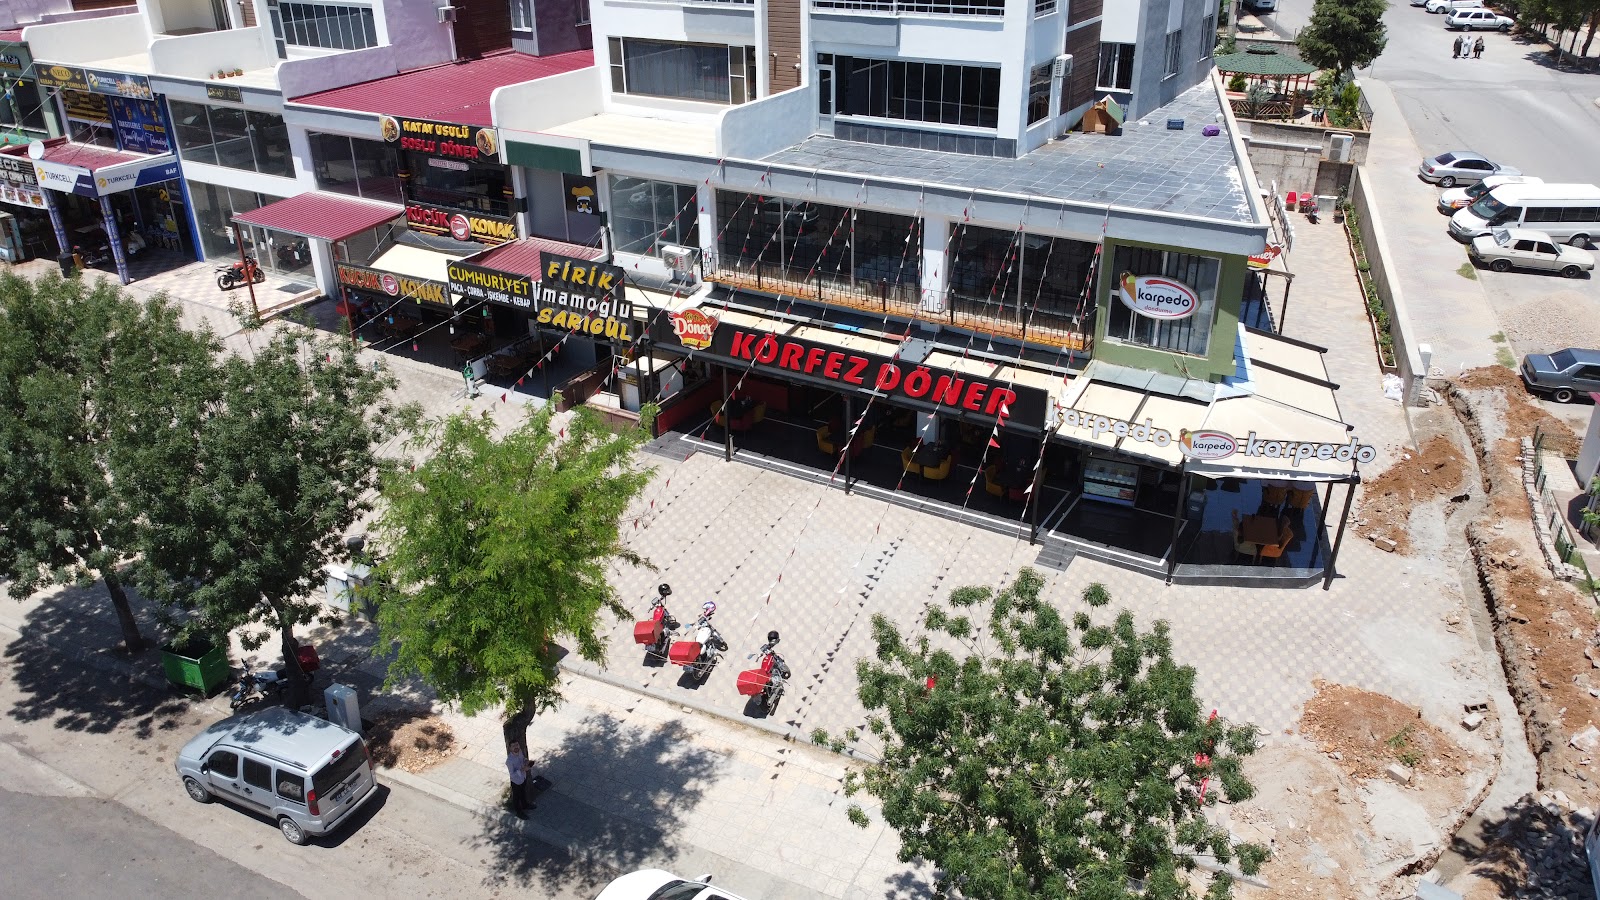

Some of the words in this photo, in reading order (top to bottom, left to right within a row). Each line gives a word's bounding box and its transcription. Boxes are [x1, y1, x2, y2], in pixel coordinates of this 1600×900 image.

[52, 68, 70, 78] NECO
[402, 120, 434, 136] HATAY
[435, 124, 470, 140] USULÜ
[400, 136, 437, 153] SOSLU
[439, 139, 480, 160] DÖNER
[44, 171, 73, 184] TURKCELL
[106, 173, 137, 185] TURKCELL
[405, 204, 451, 227] KÜÇÜK
[469, 217, 516, 240] KONAK
[448, 266, 529, 296] CUMHURİYET
[547, 260, 613, 291] FİRİK
[399, 277, 446, 305] KONAK
[467, 285, 484, 298] ÇORBA
[512, 295, 531, 308] KEBAP
[1138, 287, 1190, 307] karpedo
[536, 306, 633, 342] SARIGÜL
[673, 317, 714, 336] Döner
[730, 329, 869, 386] KÖRFEZ
[875, 361, 1018, 419] DÖNER
[1045, 395, 1172, 447] karpedo
[1192, 440, 1232, 452] karpedo
[1244, 430, 1377, 467] karpedo
